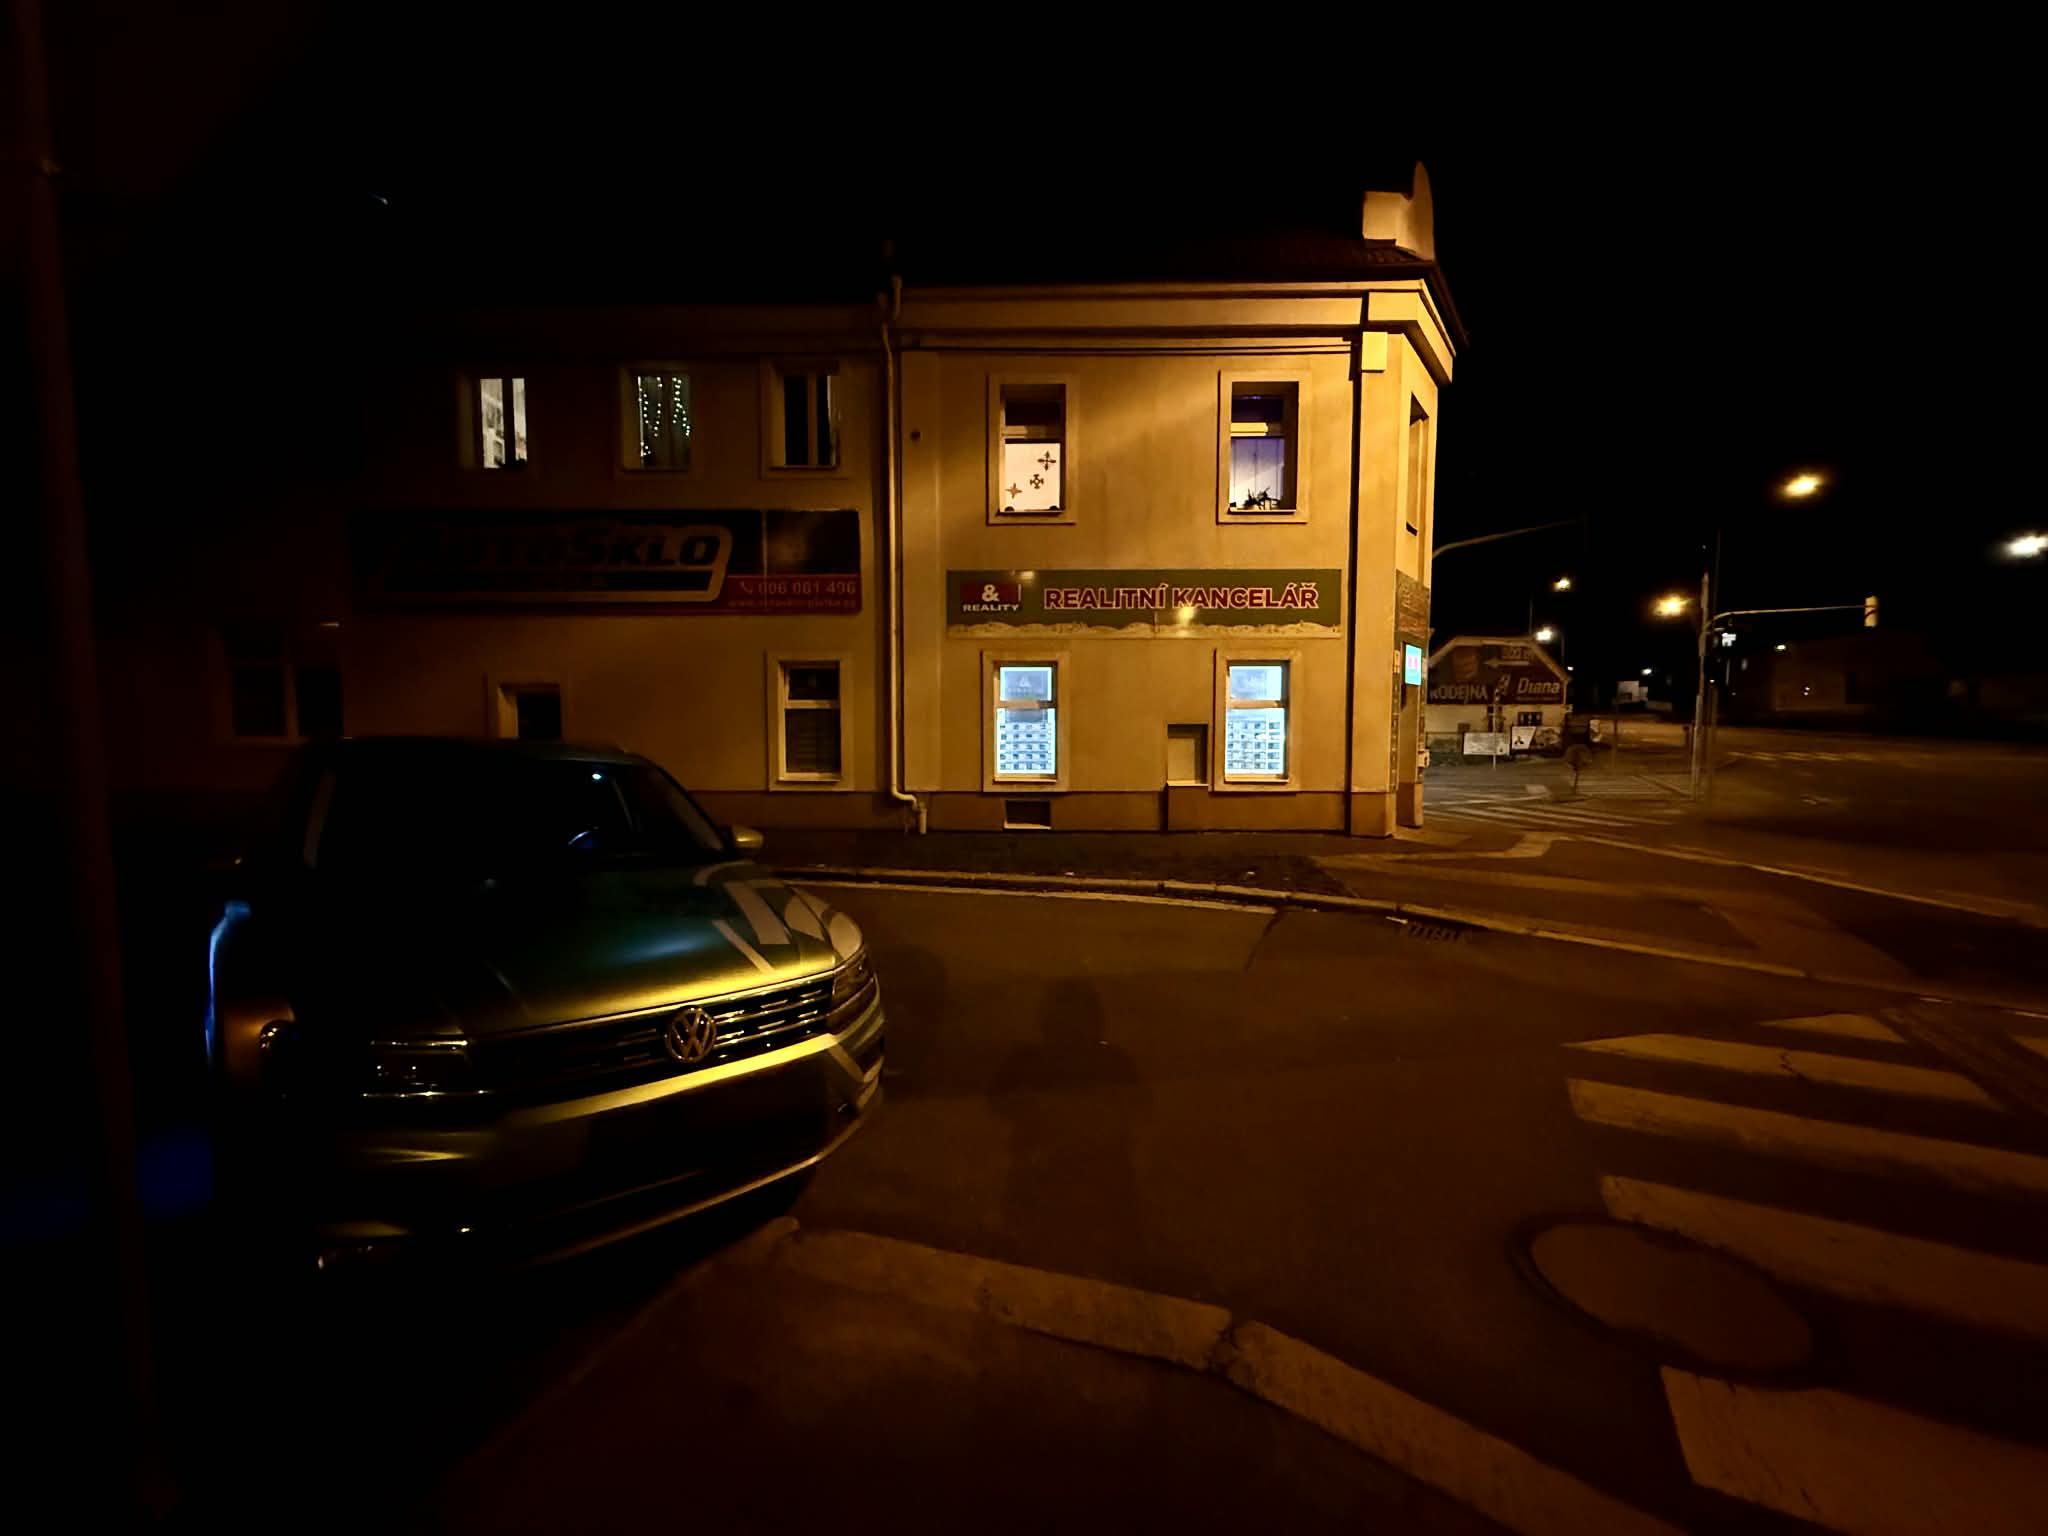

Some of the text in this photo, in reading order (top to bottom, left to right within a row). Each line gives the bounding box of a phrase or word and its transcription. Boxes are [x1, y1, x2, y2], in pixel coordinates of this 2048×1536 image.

[981, 584, 1000, 602] &
[1044, 582, 1318, 609] REALITNÍ KANCELÁŘ
[962, 604, 1019, 612] REALITY
[1517, 678, 1560, 695] Diana
